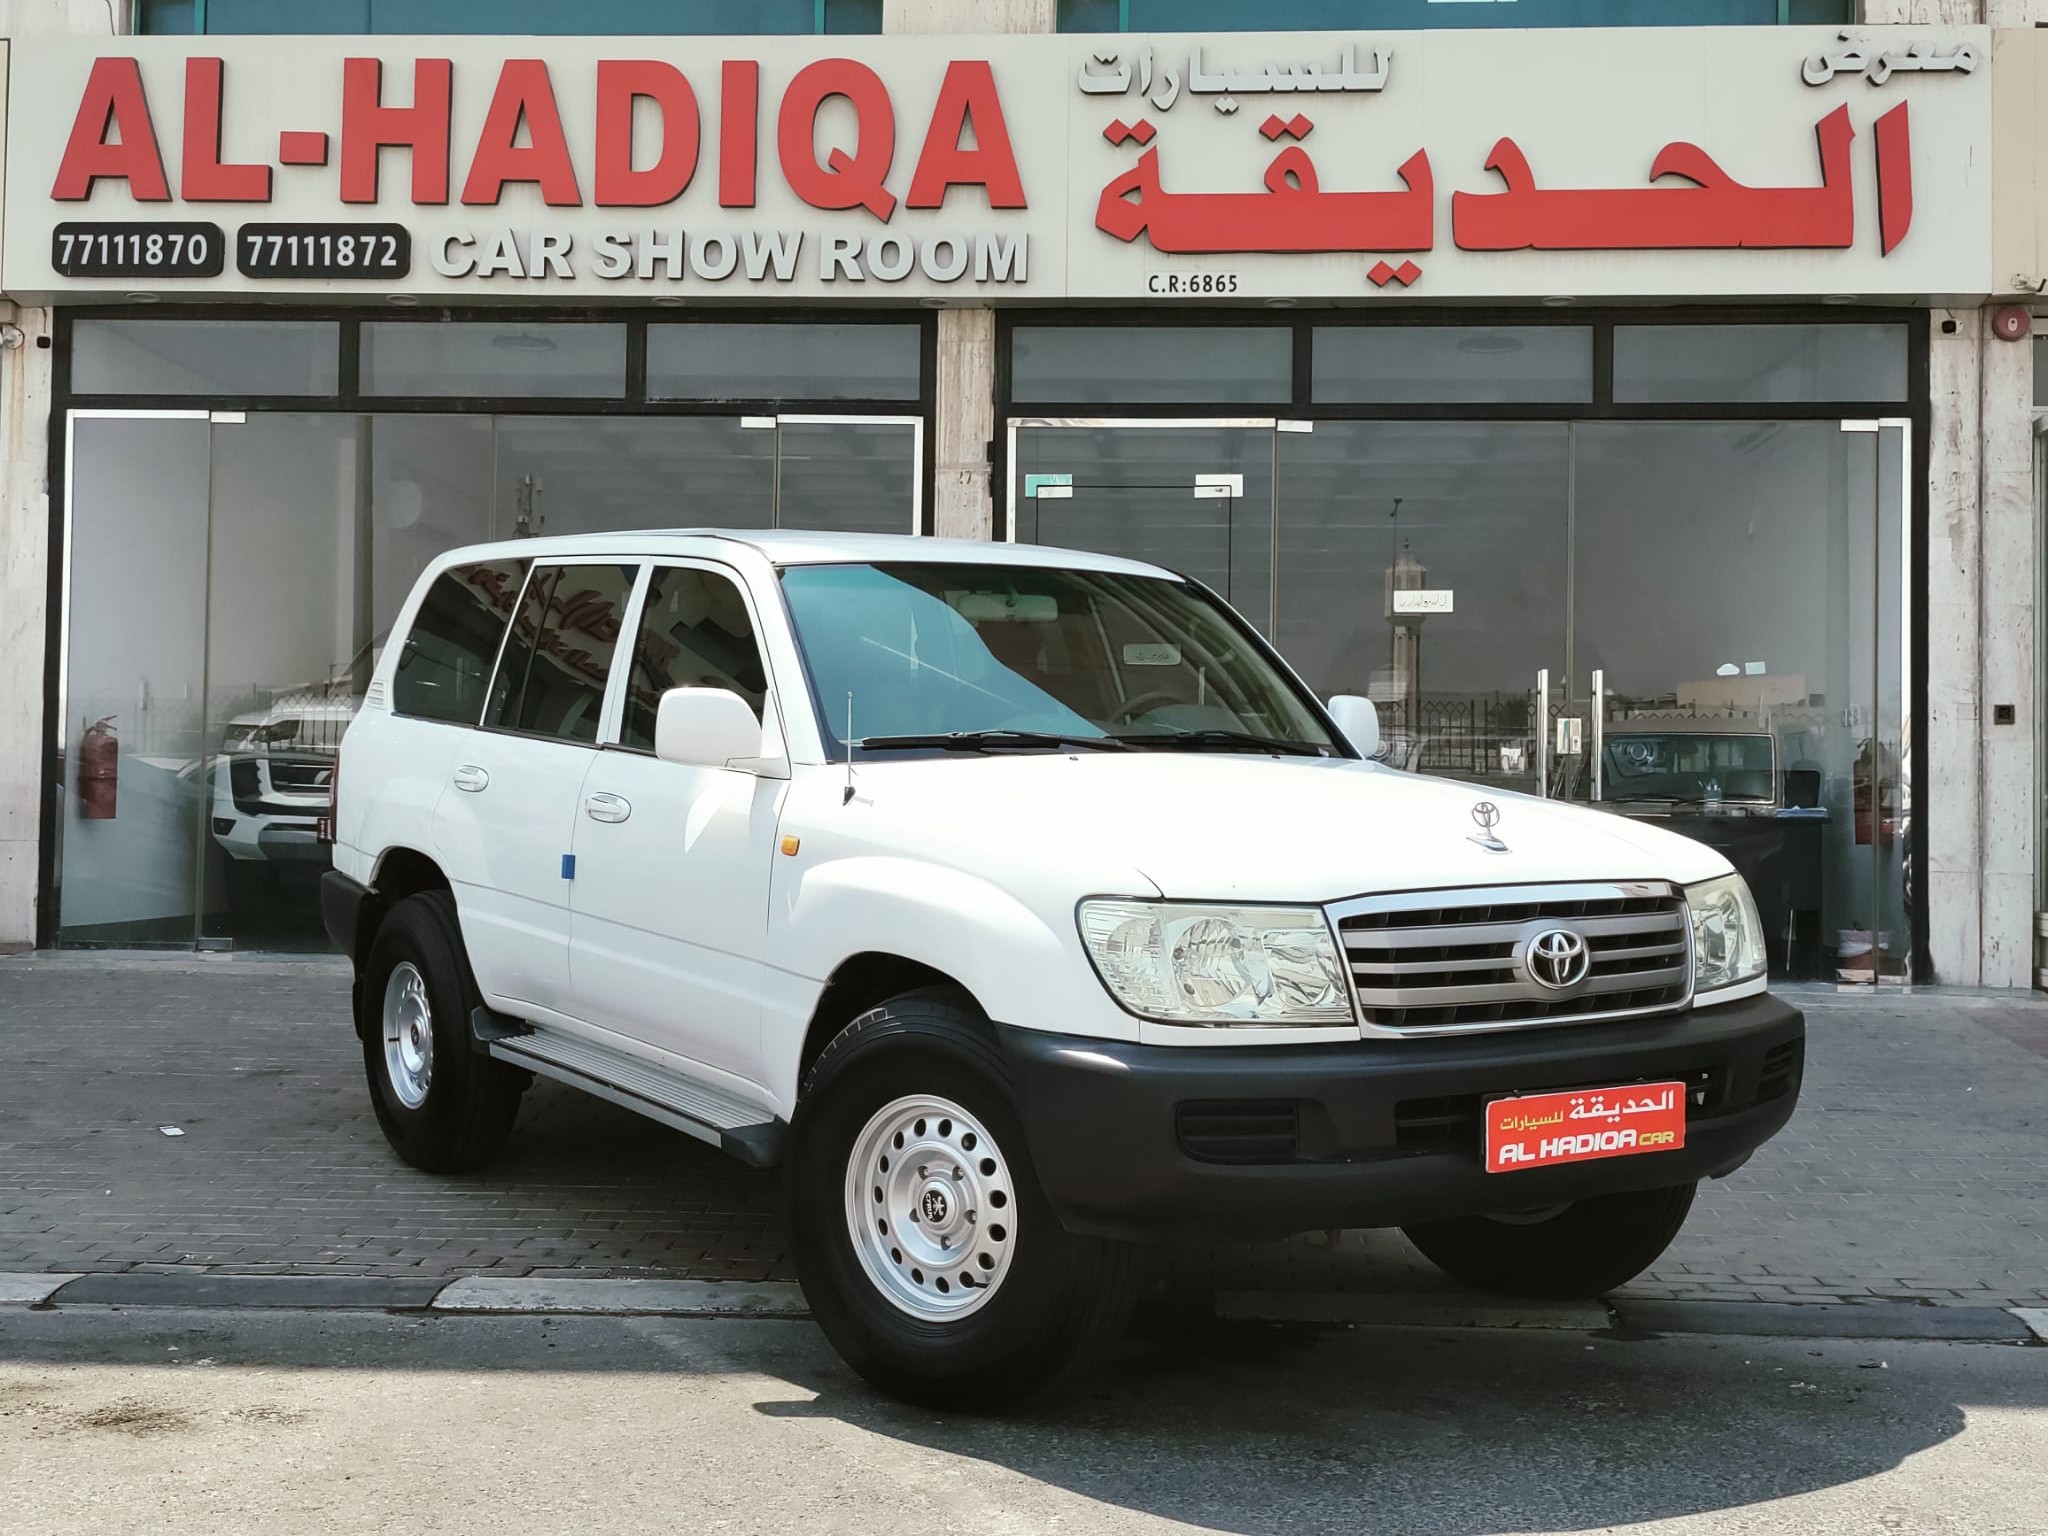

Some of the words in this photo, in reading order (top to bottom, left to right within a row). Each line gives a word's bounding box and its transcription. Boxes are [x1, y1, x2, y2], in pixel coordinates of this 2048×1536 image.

[1079, 46, 1394, 115] للسيارات
[1803, 29, 1979, 88] معرض
[51, 57, 1029, 222] AL-HADIQA
[1095, 99, 1914, 287] الحديقة
[58, 234, 208, 265] 77111870
[247, 235, 398, 267] 77111872
[430, 228, 574, 279] CAR
[592, 229, 804, 281] SHOW
[820, 231, 1028, 283] ROOM
[1148, 274, 1238, 293] C.R:6865
[1569, 1090, 1675, 1123] الحديقة
[1499, 1142, 1535, 1165] AL
[1638, 1130, 1675, 1146] CAR
